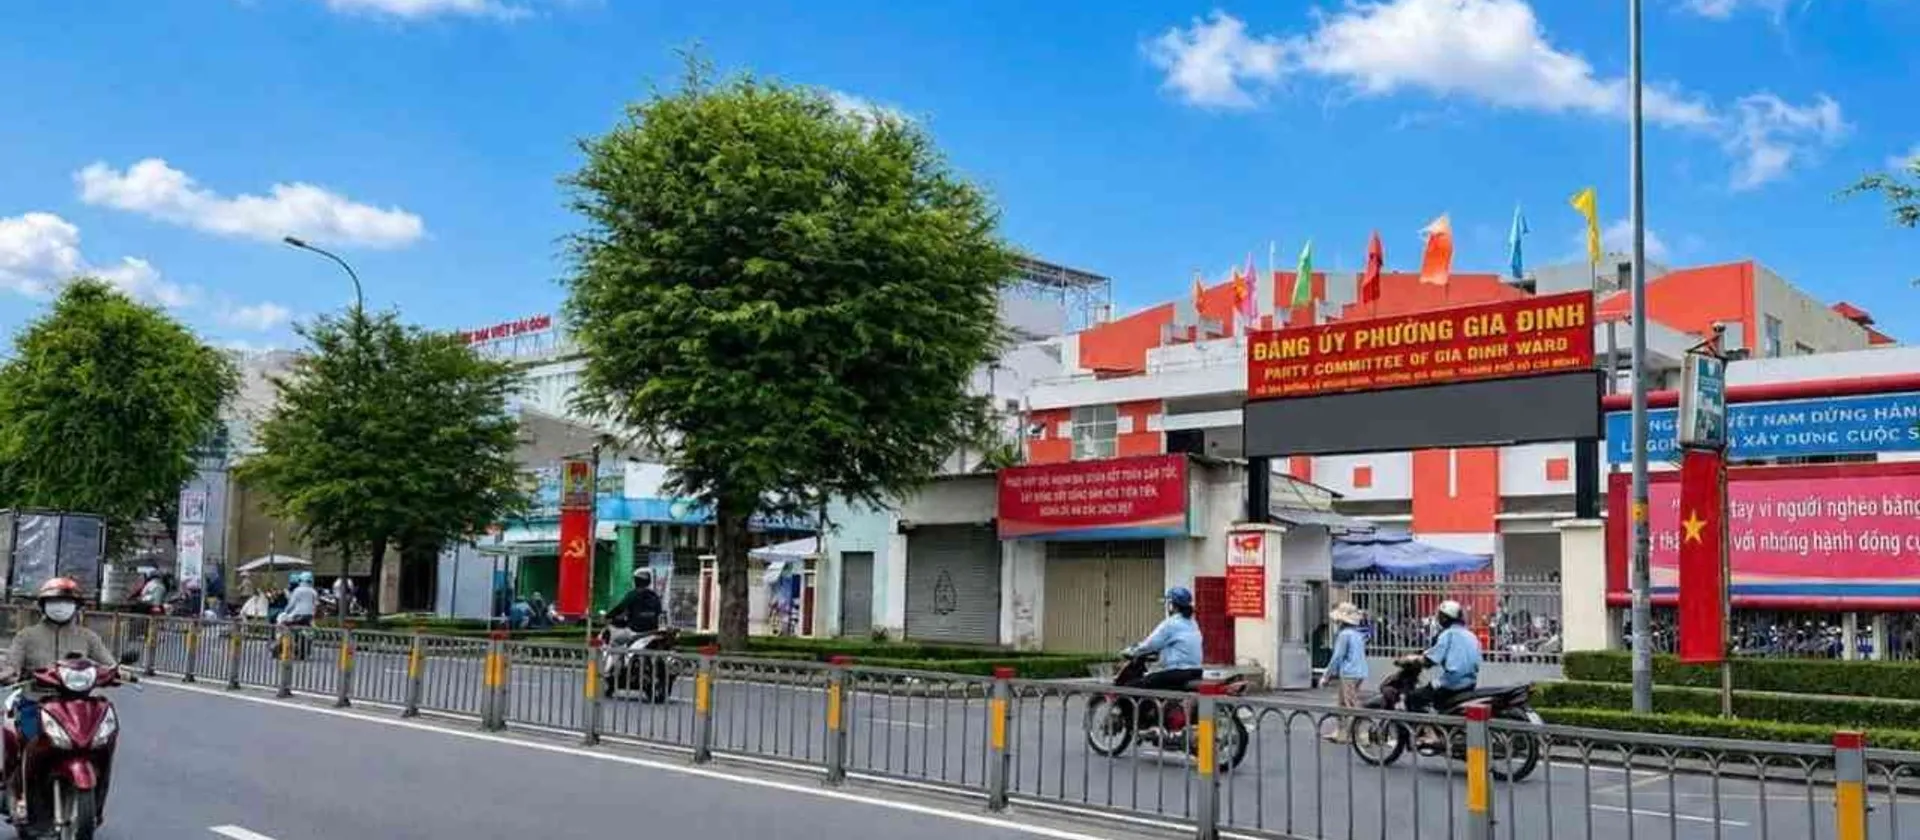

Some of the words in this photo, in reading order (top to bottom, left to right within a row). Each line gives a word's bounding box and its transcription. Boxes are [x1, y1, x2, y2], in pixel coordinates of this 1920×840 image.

[1464, 313, 1507, 338] GIA
[1517, 303, 1585, 336] ĐỊNH
[1265, 364, 1309, 381] PARTY
[1314, 353, 1405, 377] COMMITTEE
[1410, 351, 1430, 367] OF
[1435, 348, 1463, 364] GIA
[1516, 337, 1568, 355] WARD
[1762, 411, 1805, 427] NAM
[1731, 498, 1755, 523] tay
